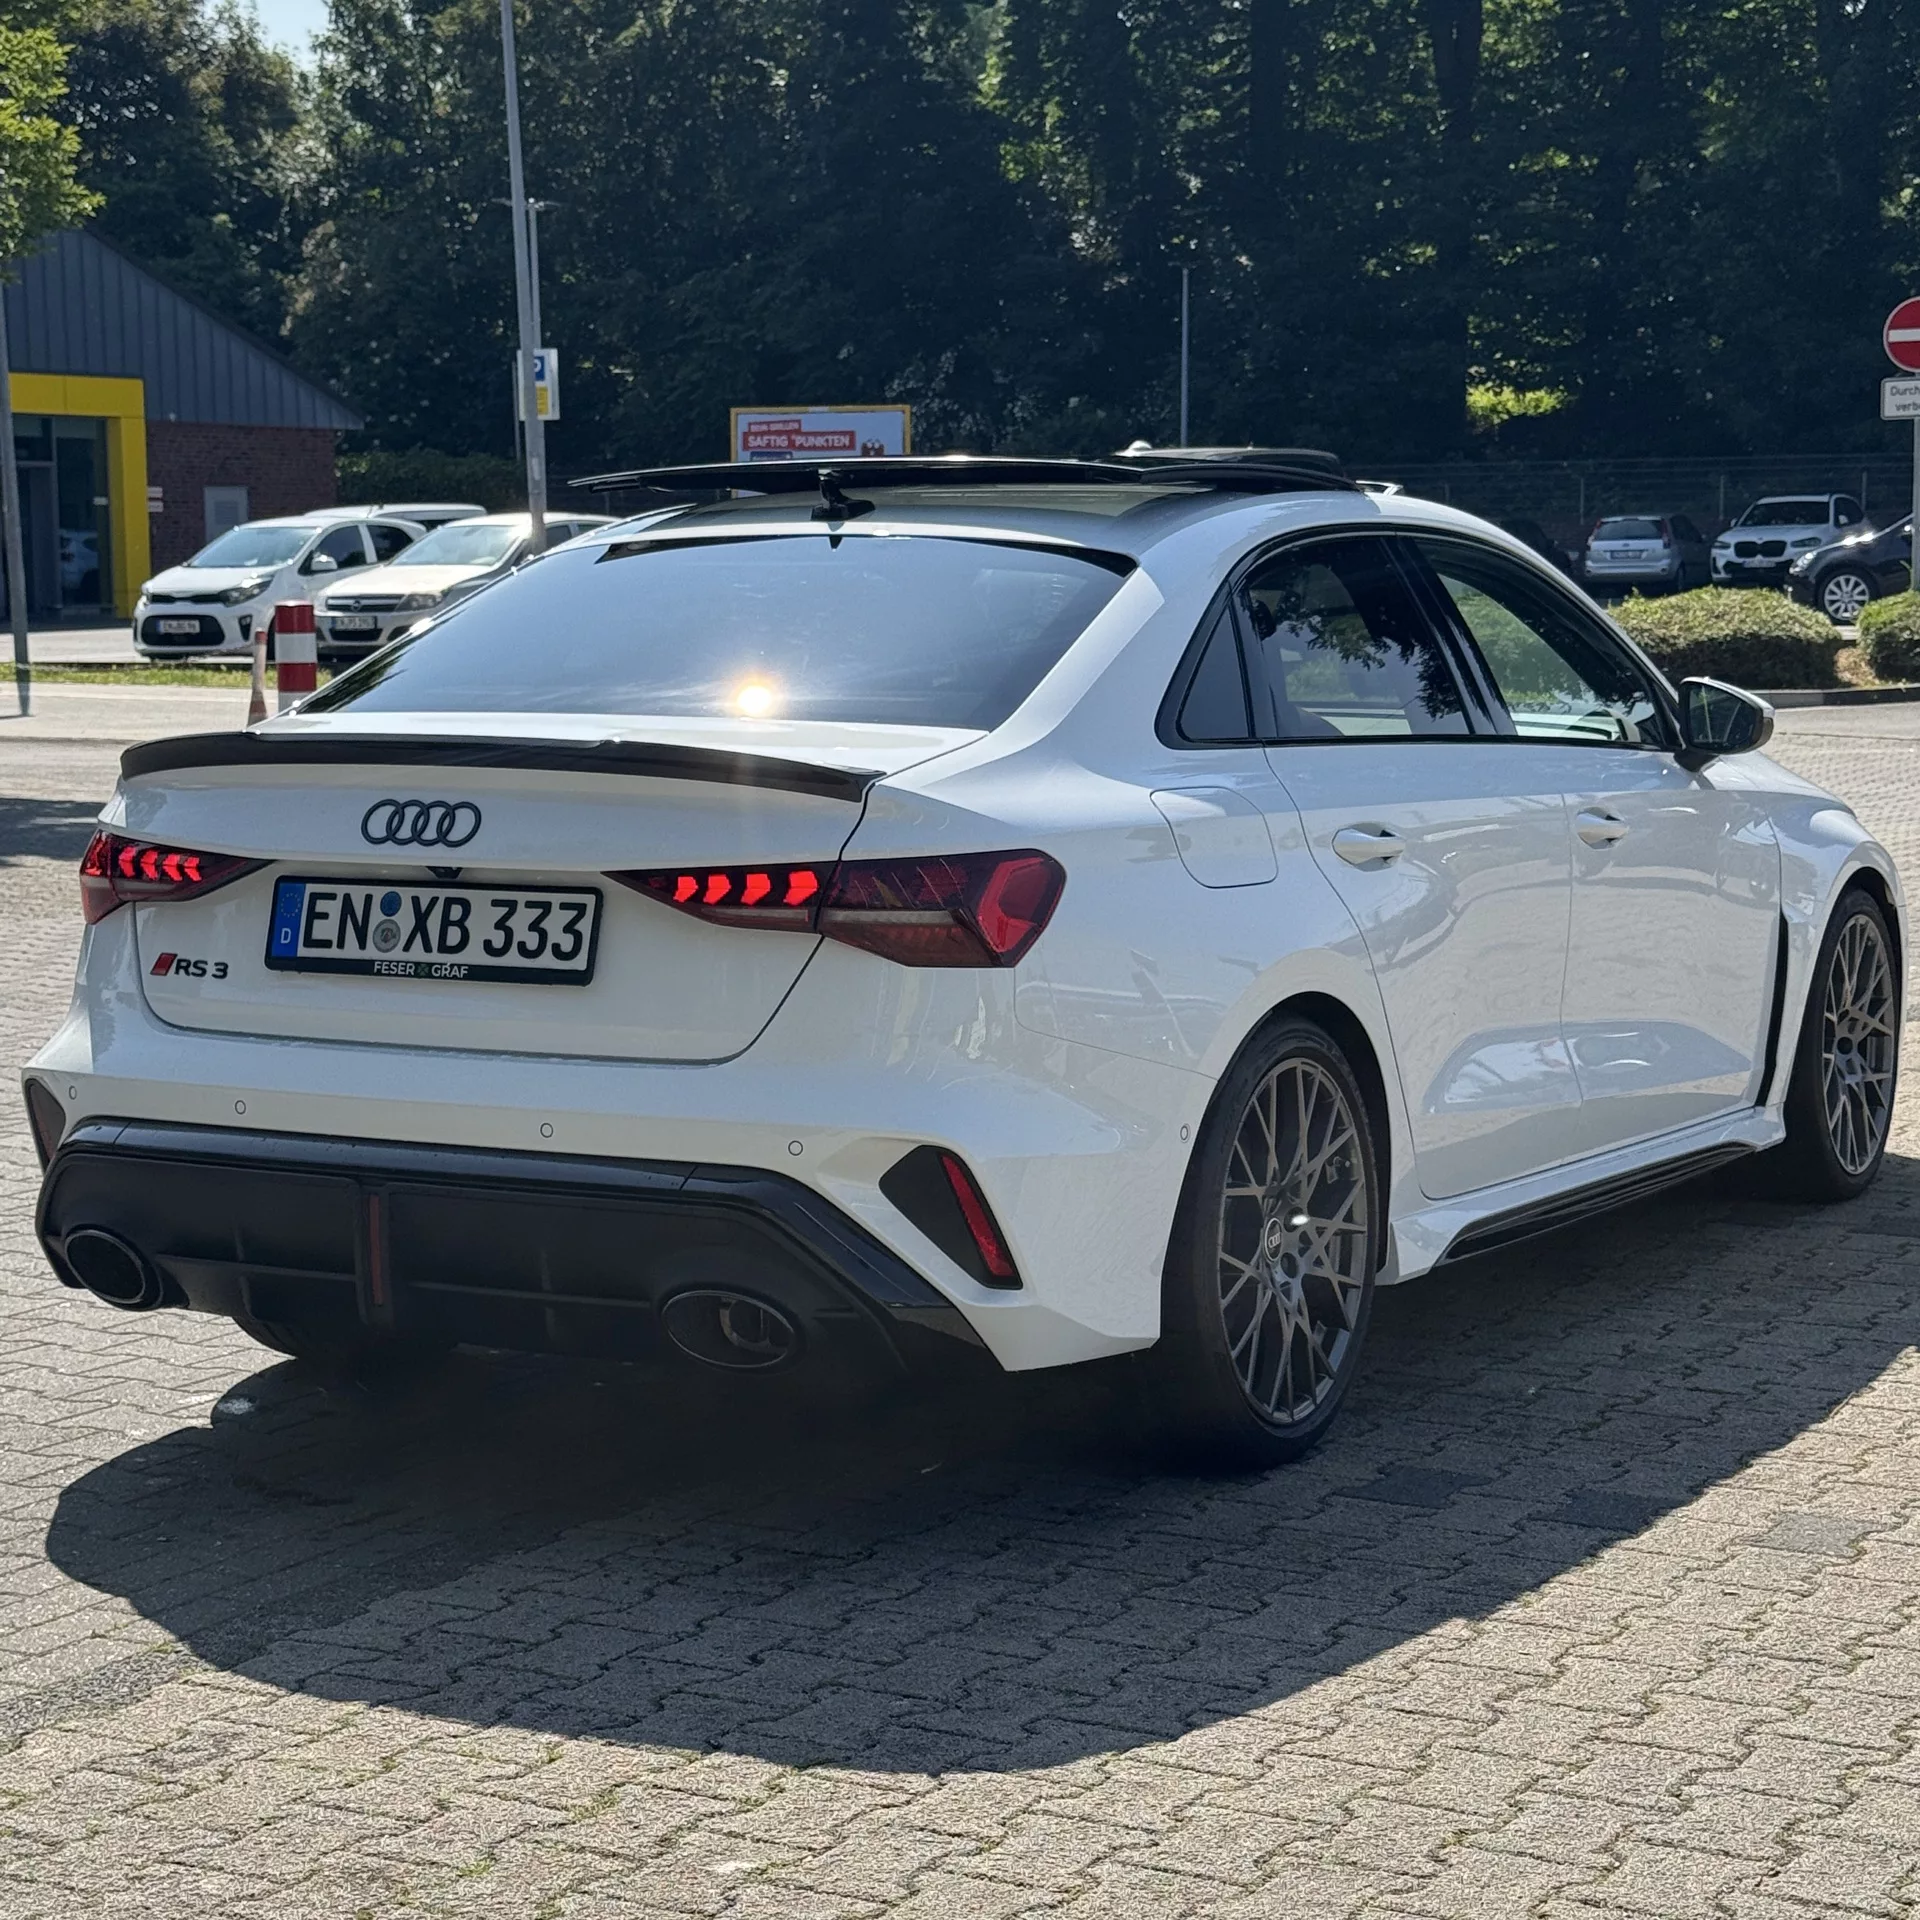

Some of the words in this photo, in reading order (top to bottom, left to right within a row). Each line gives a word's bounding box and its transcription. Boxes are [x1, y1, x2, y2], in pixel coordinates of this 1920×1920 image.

[748, 435, 788, 447] SAFTIG
[302, 892, 373, 950] EN
[402, 895, 472, 954] XB
[483, 898, 587, 961] 333
[280, 927, 291, 944] D
[373, 961, 415, 976] FESER
[431, 963, 469, 979] GRAF
